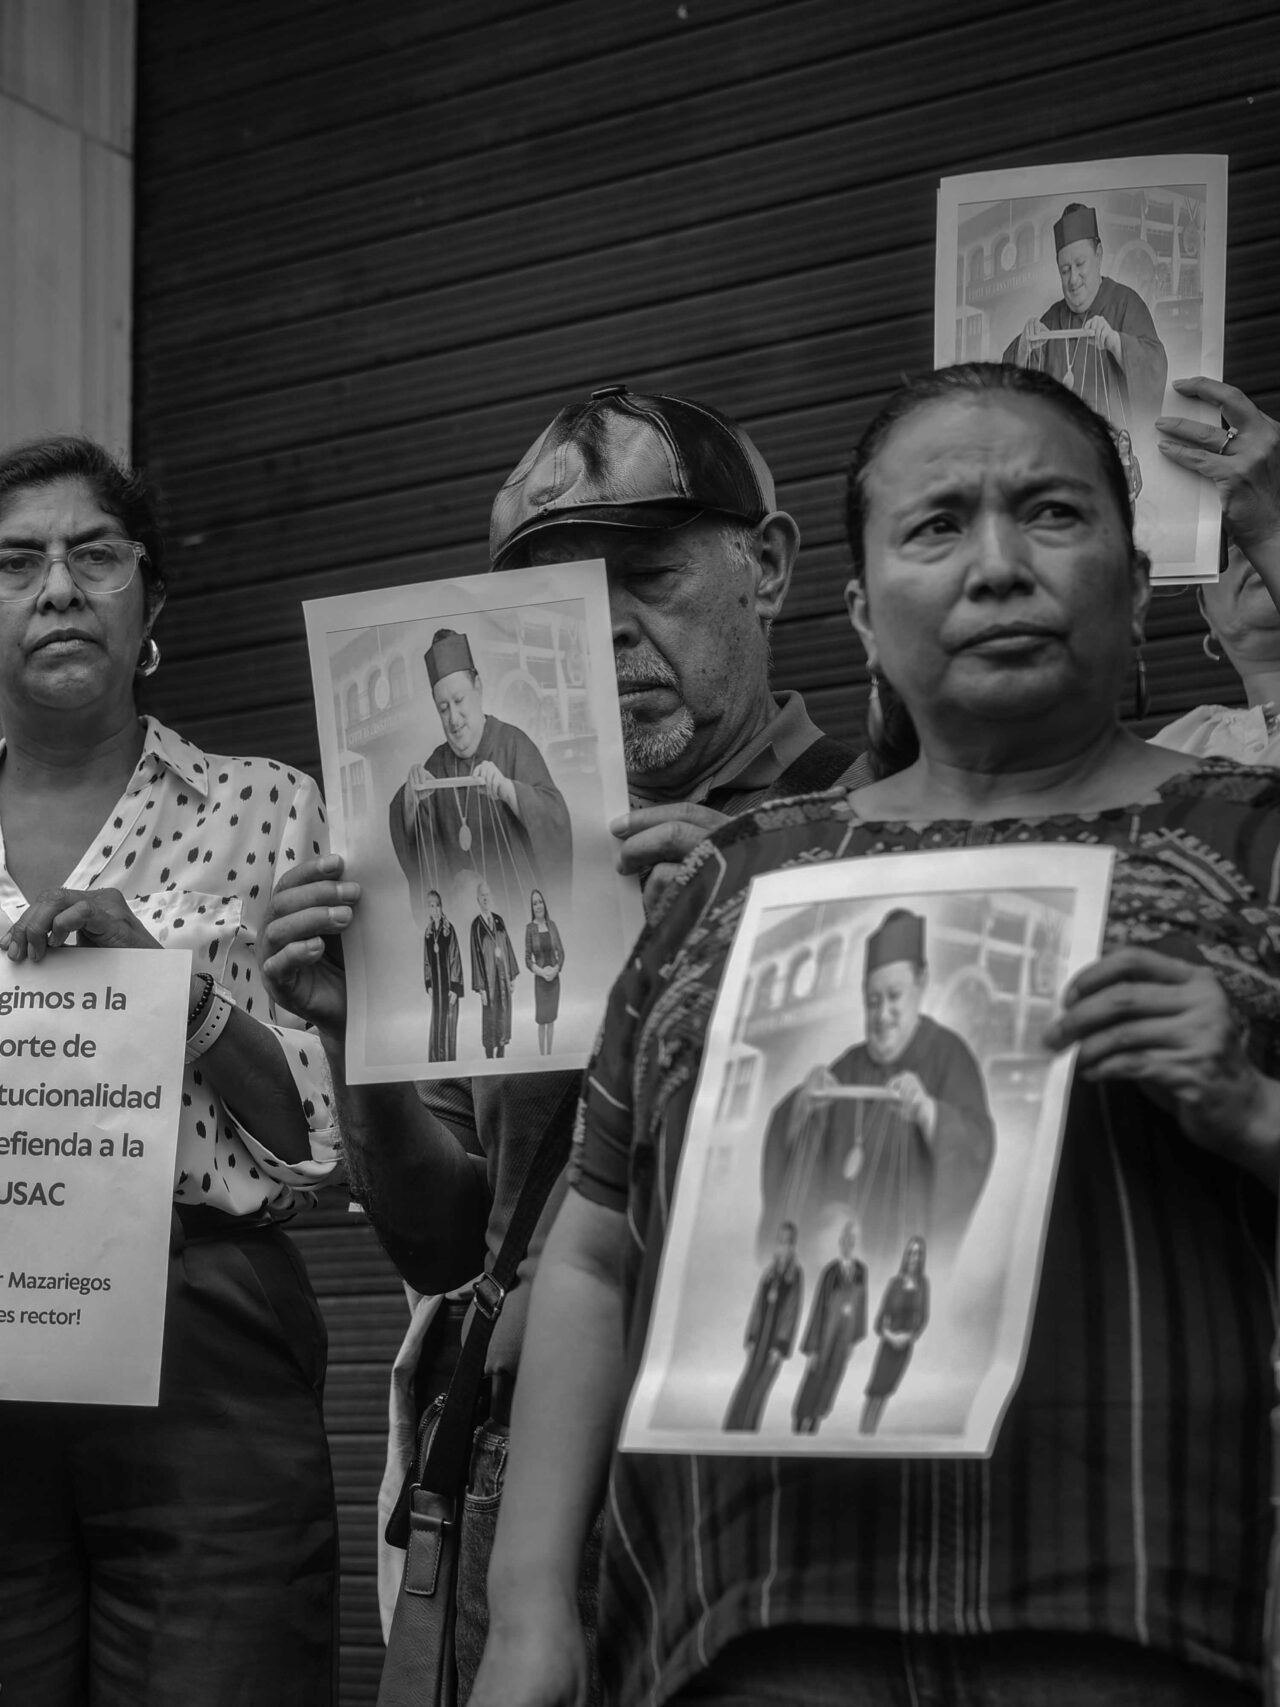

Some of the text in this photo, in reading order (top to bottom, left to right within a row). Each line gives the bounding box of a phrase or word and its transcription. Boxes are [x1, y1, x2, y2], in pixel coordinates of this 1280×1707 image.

[82, 992, 98, 1010] a
[104, 986, 127, 1011] la
[63, 1034, 97, 1058] de
[100, 1139, 115, 1158] a
[122, 1133, 145, 1158] la
[8, 1271, 112, 1296] Mazariegos
[19, 1307, 81, 1326] rector!
